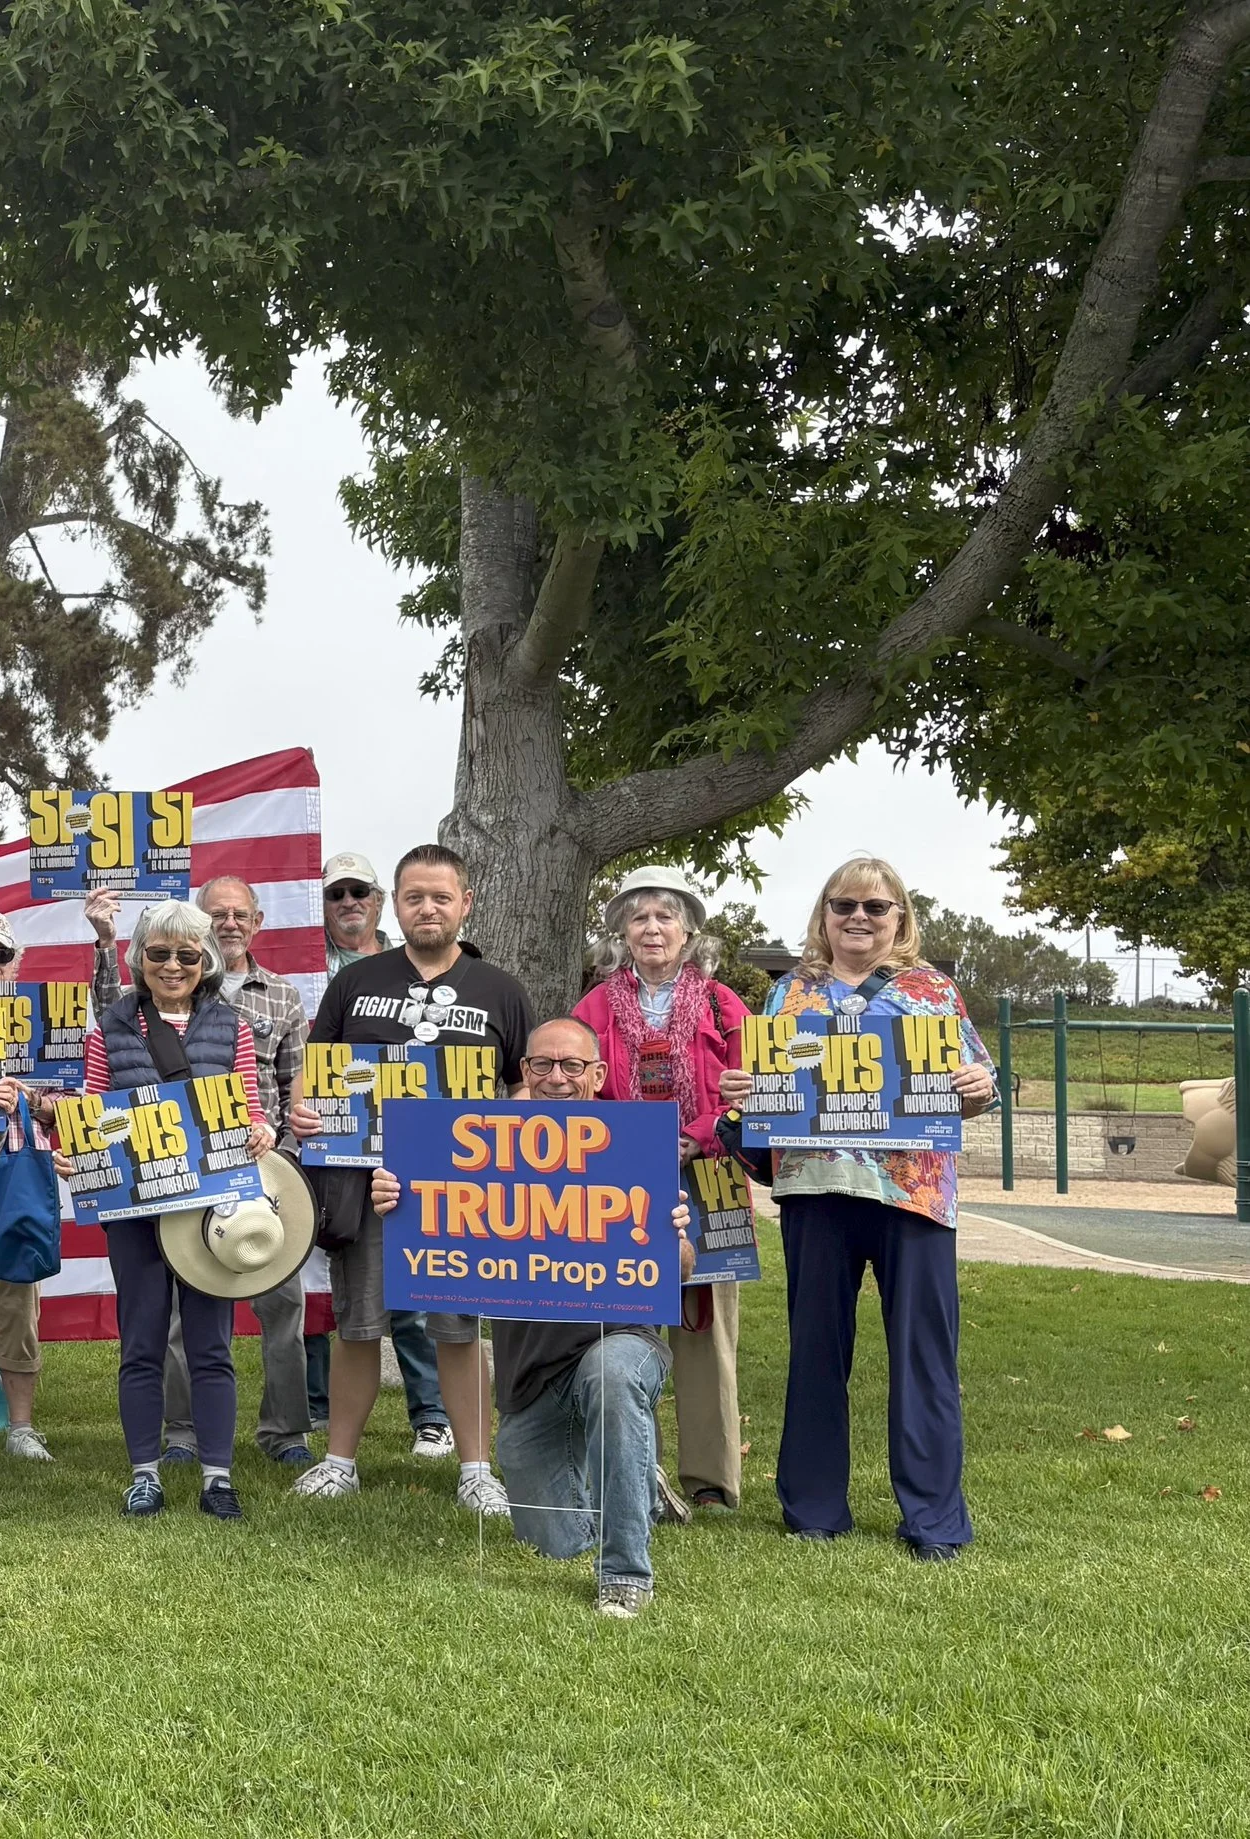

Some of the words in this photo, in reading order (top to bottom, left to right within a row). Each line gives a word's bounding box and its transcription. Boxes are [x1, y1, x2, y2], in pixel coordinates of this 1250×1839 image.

[90, 792, 134, 868] SI
[71, 845, 79, 856] 50
[0, 981, 17, 995] VOTE
[352, 996, 401, 1018] FIGHT
[836, 1016, 862, 1033] VOTE
[51, 1028, 61, 1043] ON
[62, 1028, 81, 1042] PROP
[742, 1016, 798, 1074] YES
[45, 1044, 83, 1059] NOVEMBER
[387, 1045, 409, 1061] VOTE
[303, 1043, 353, 1098] YES
[820, 1033, 884, 1093] YES
[136, 1085, 160, 1104] VOTE
[826, 1093, 839, 1112] ON
[840, 1093, 866, 1112] PROP
[866, 1092, 880, 1111] 50
[315, 1098, 338, 1115] PROP
[338, 1098, 350, 1115] 50
[129, 1100, 188, 1162] YES
[341, 1116, 358, 1133] 4TH
[820, 1112, 871, 1131] NOVEMBER
[871, 1111, 889, 1130] 4TH
[452, 1114, 611, 1172] STOP
[140, 1161, 154, 1180] ON
[153, 1157, 177, 1178] PROP
[176, 1155, 190, 1174] 50
[137, 1175, 185, 1200] NOVEMBER
[182, 1172, 200, 1191] 4TH
[410, 1180, 649, 1245] TRUMP!
[708, 1212, 723, 1230] ON
[724, 1209, 745, 1229] PROP
[704, 1227, 754, 1250] NOVEMBER
[402, 1248, 468, 1278] YES
[478, 1257, 517, 1281] on
[529, 1254, 606, 1291] Prop
[616, 1258, 659, 1287] 50
